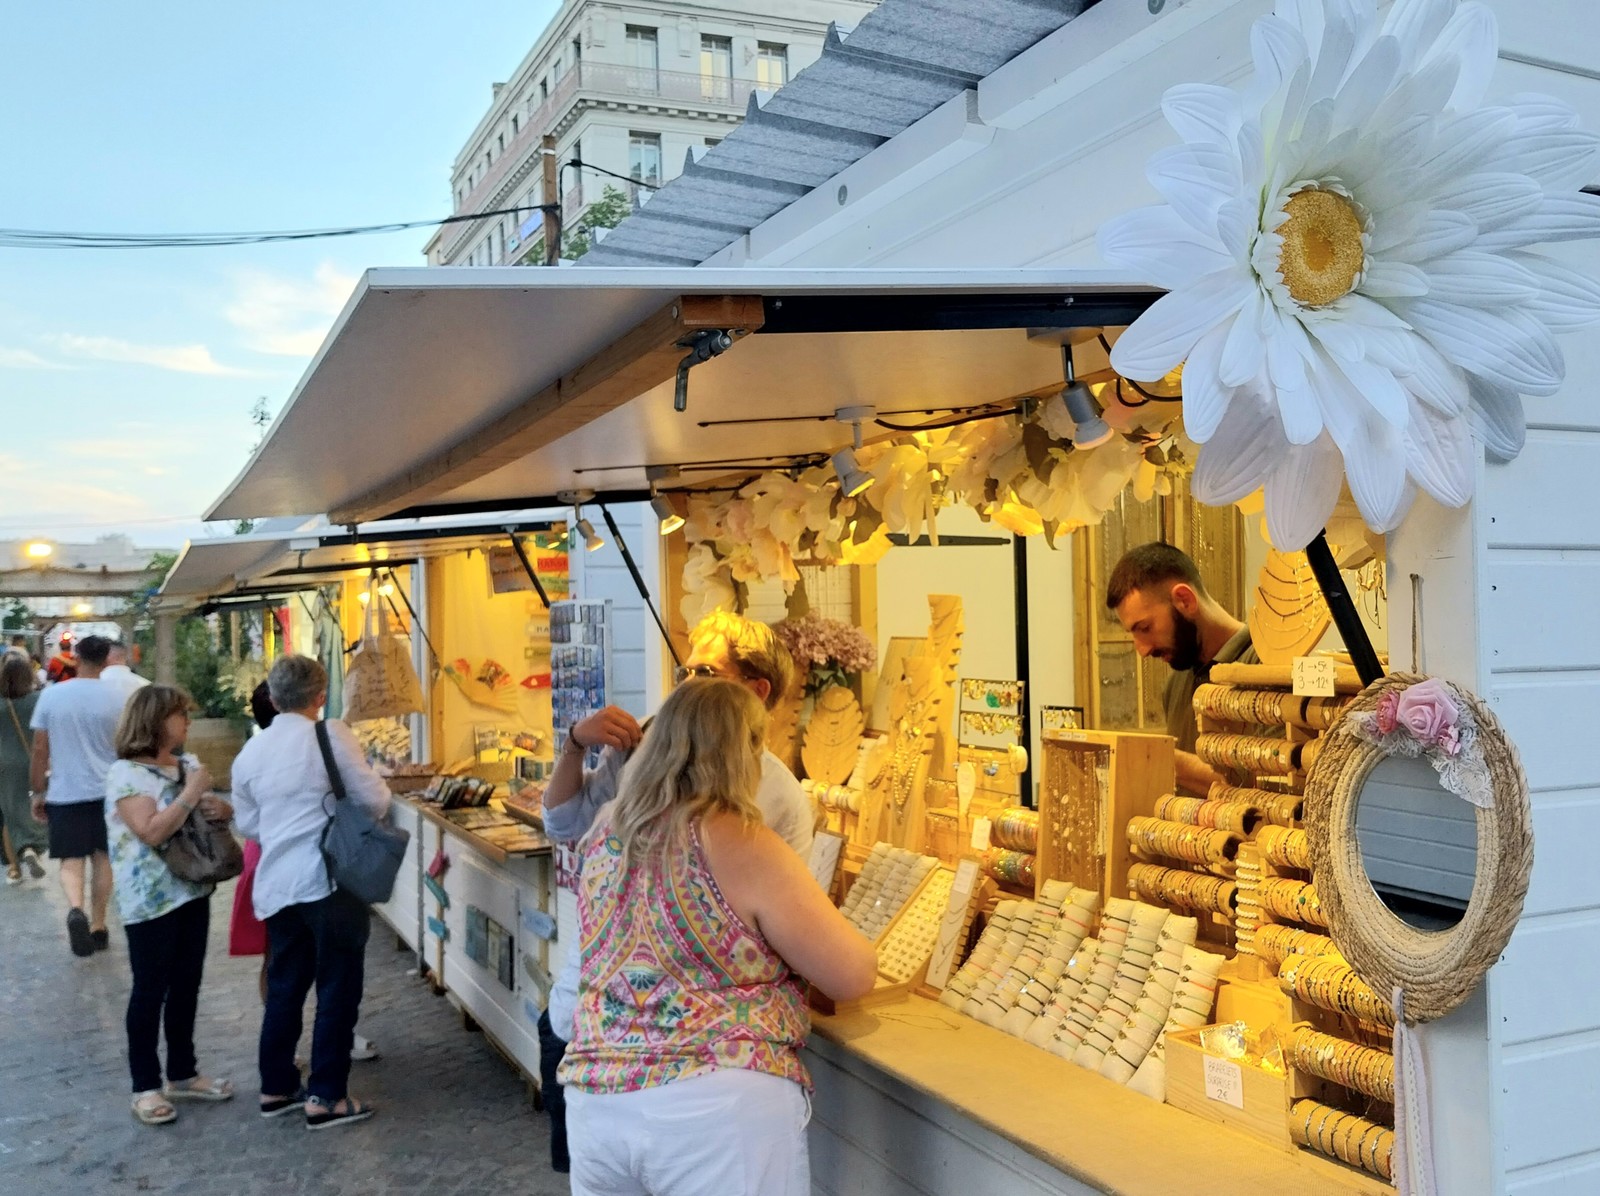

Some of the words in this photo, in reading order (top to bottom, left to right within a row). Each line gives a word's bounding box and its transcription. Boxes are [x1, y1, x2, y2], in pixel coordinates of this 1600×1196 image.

[1298, 661, 1304, 672] 1
[1298, 675, 1305, 689] 3
[1217, 1089, 1228, 1100] 2€
